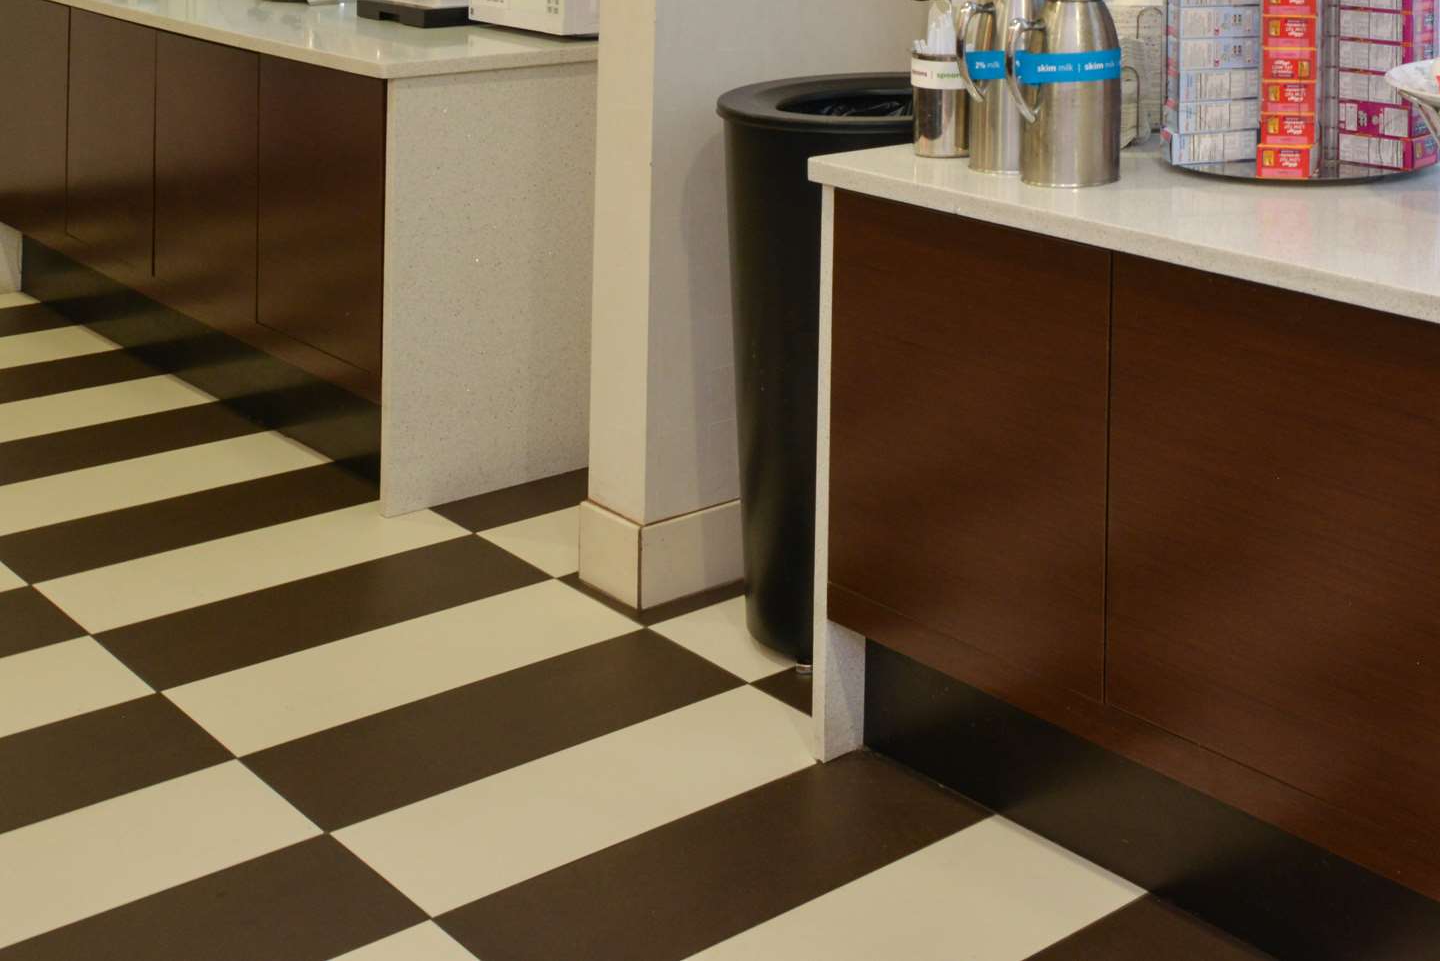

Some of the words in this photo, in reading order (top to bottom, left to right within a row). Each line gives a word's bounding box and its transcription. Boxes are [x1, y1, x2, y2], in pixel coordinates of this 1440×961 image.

[1037, 64, 1057, 73] skim
[1058, 63, 1073, 72] milk
[1084, 61, 1104, 71] skim
